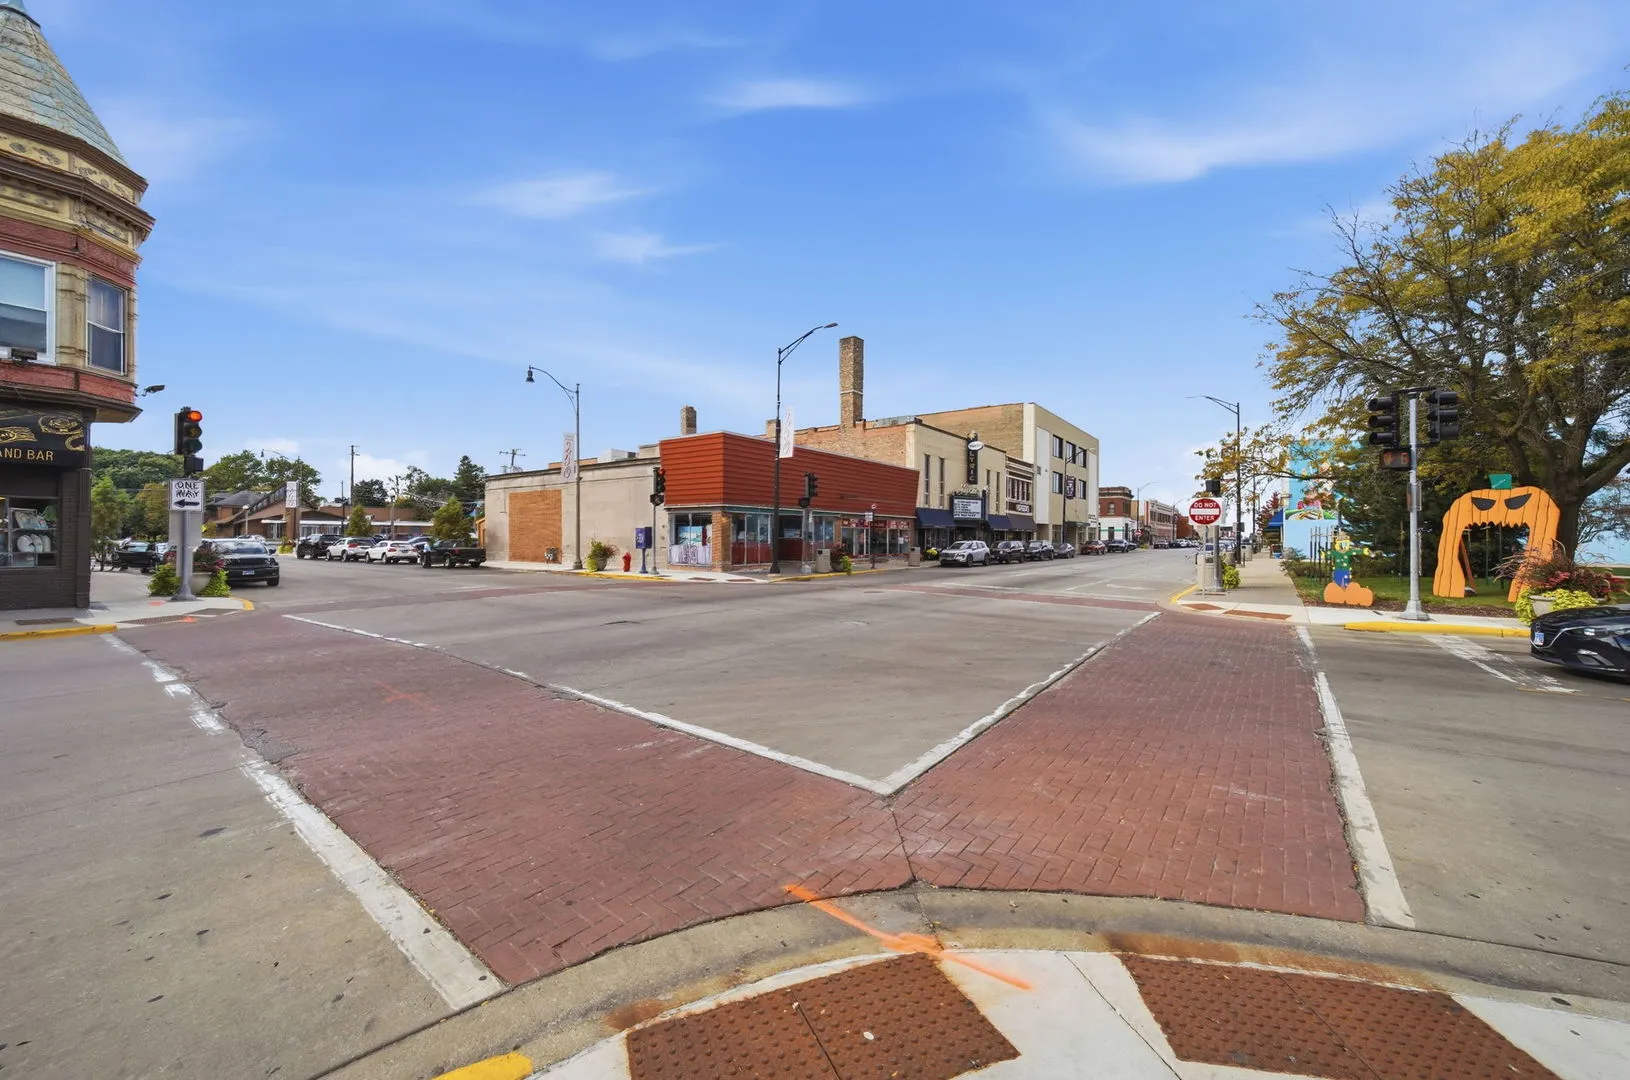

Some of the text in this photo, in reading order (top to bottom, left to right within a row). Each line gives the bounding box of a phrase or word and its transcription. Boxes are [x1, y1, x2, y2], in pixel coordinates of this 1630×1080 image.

[0, 447, 54, 461] ND BAR
[175, 481, 199, 489] ONE
[176, 490, 200, 498] WAY
